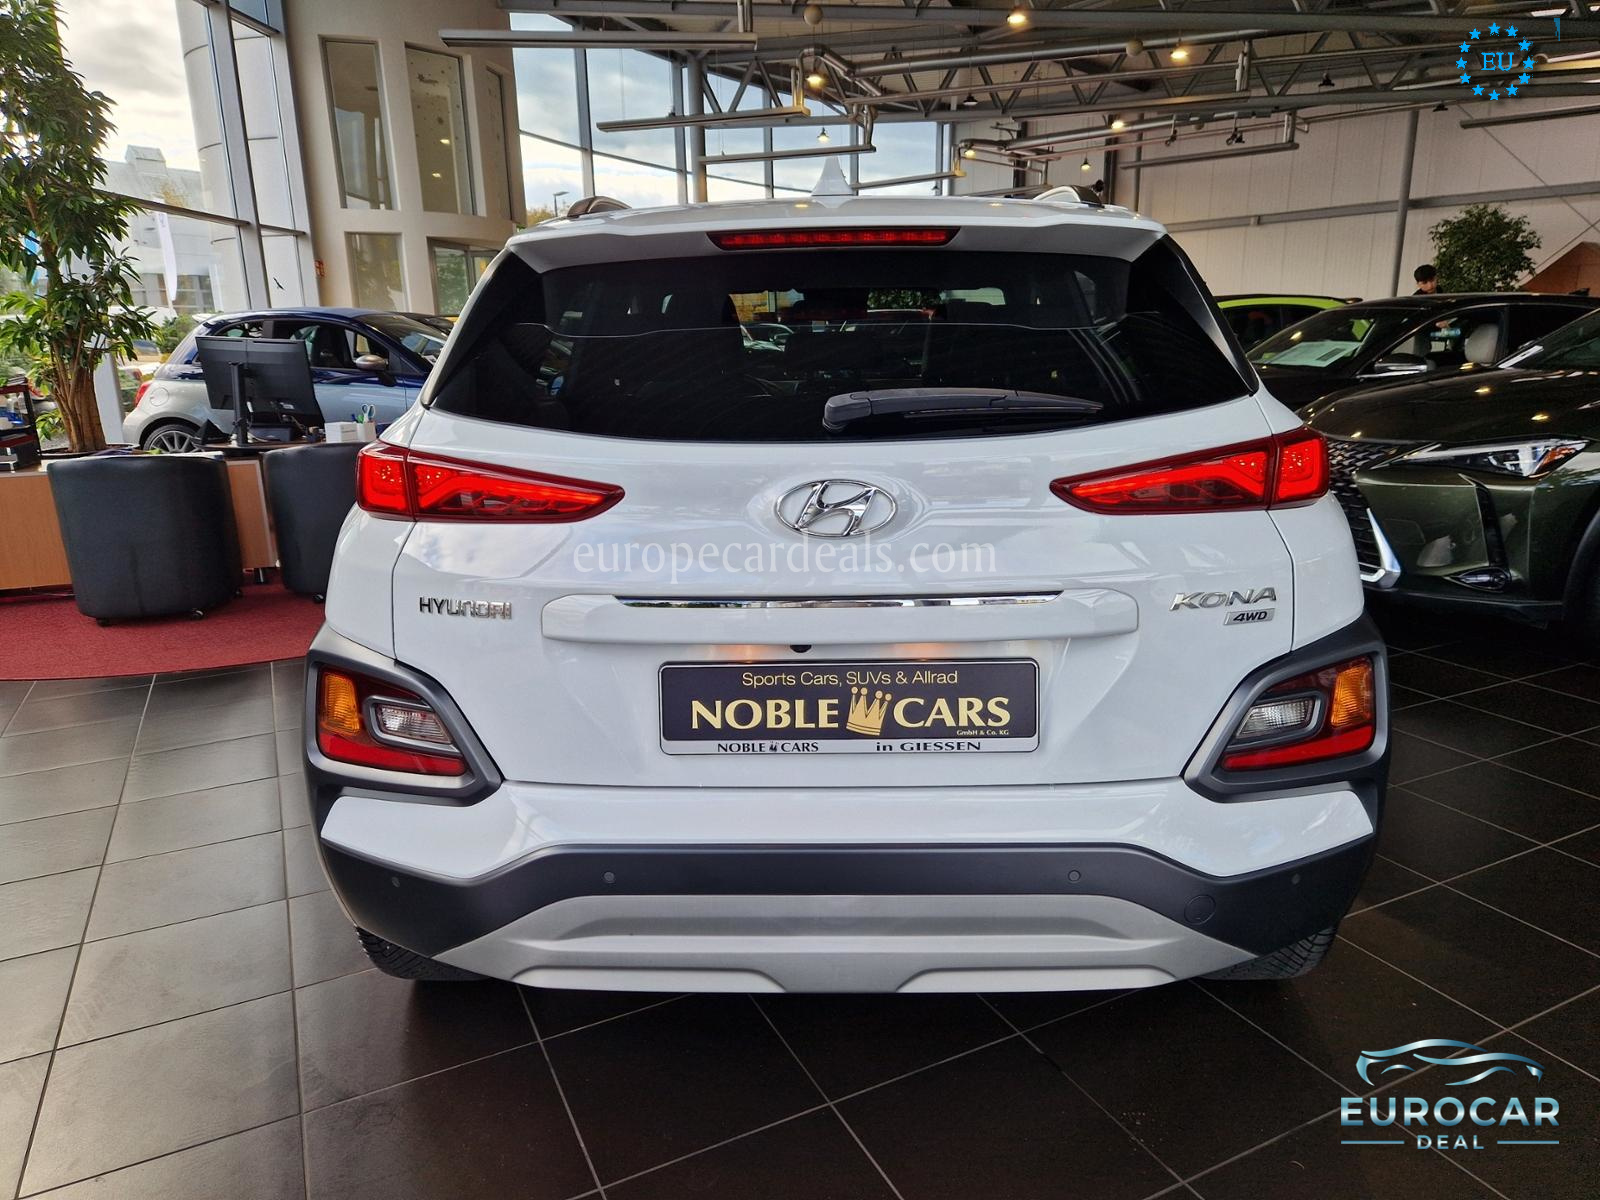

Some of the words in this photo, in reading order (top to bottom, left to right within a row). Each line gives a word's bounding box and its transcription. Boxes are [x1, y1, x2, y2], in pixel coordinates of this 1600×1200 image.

[1169, 587, 1277, 611] KONA
[419, 597, 512, 620] HYUNDAI
[1233, 610, 1268, 622] 4WD
[742, 671, 796, 688] Sports
[800, 671, 842, 687] Cars,
[846, 671, 891, 685] SUVs
[895, 671, 908, 684] &
[912, 670, 958, 684] Allrad
[691, 699, 839, 729] NOBLE
[893, 697, 1011, 727] CARS
[717, 742, 765, 752] NOBLE
[781, 742, 819, 752] CARS
[876, 742, 893, 751] in
[900, 741, 981, 751] GIESSEN
